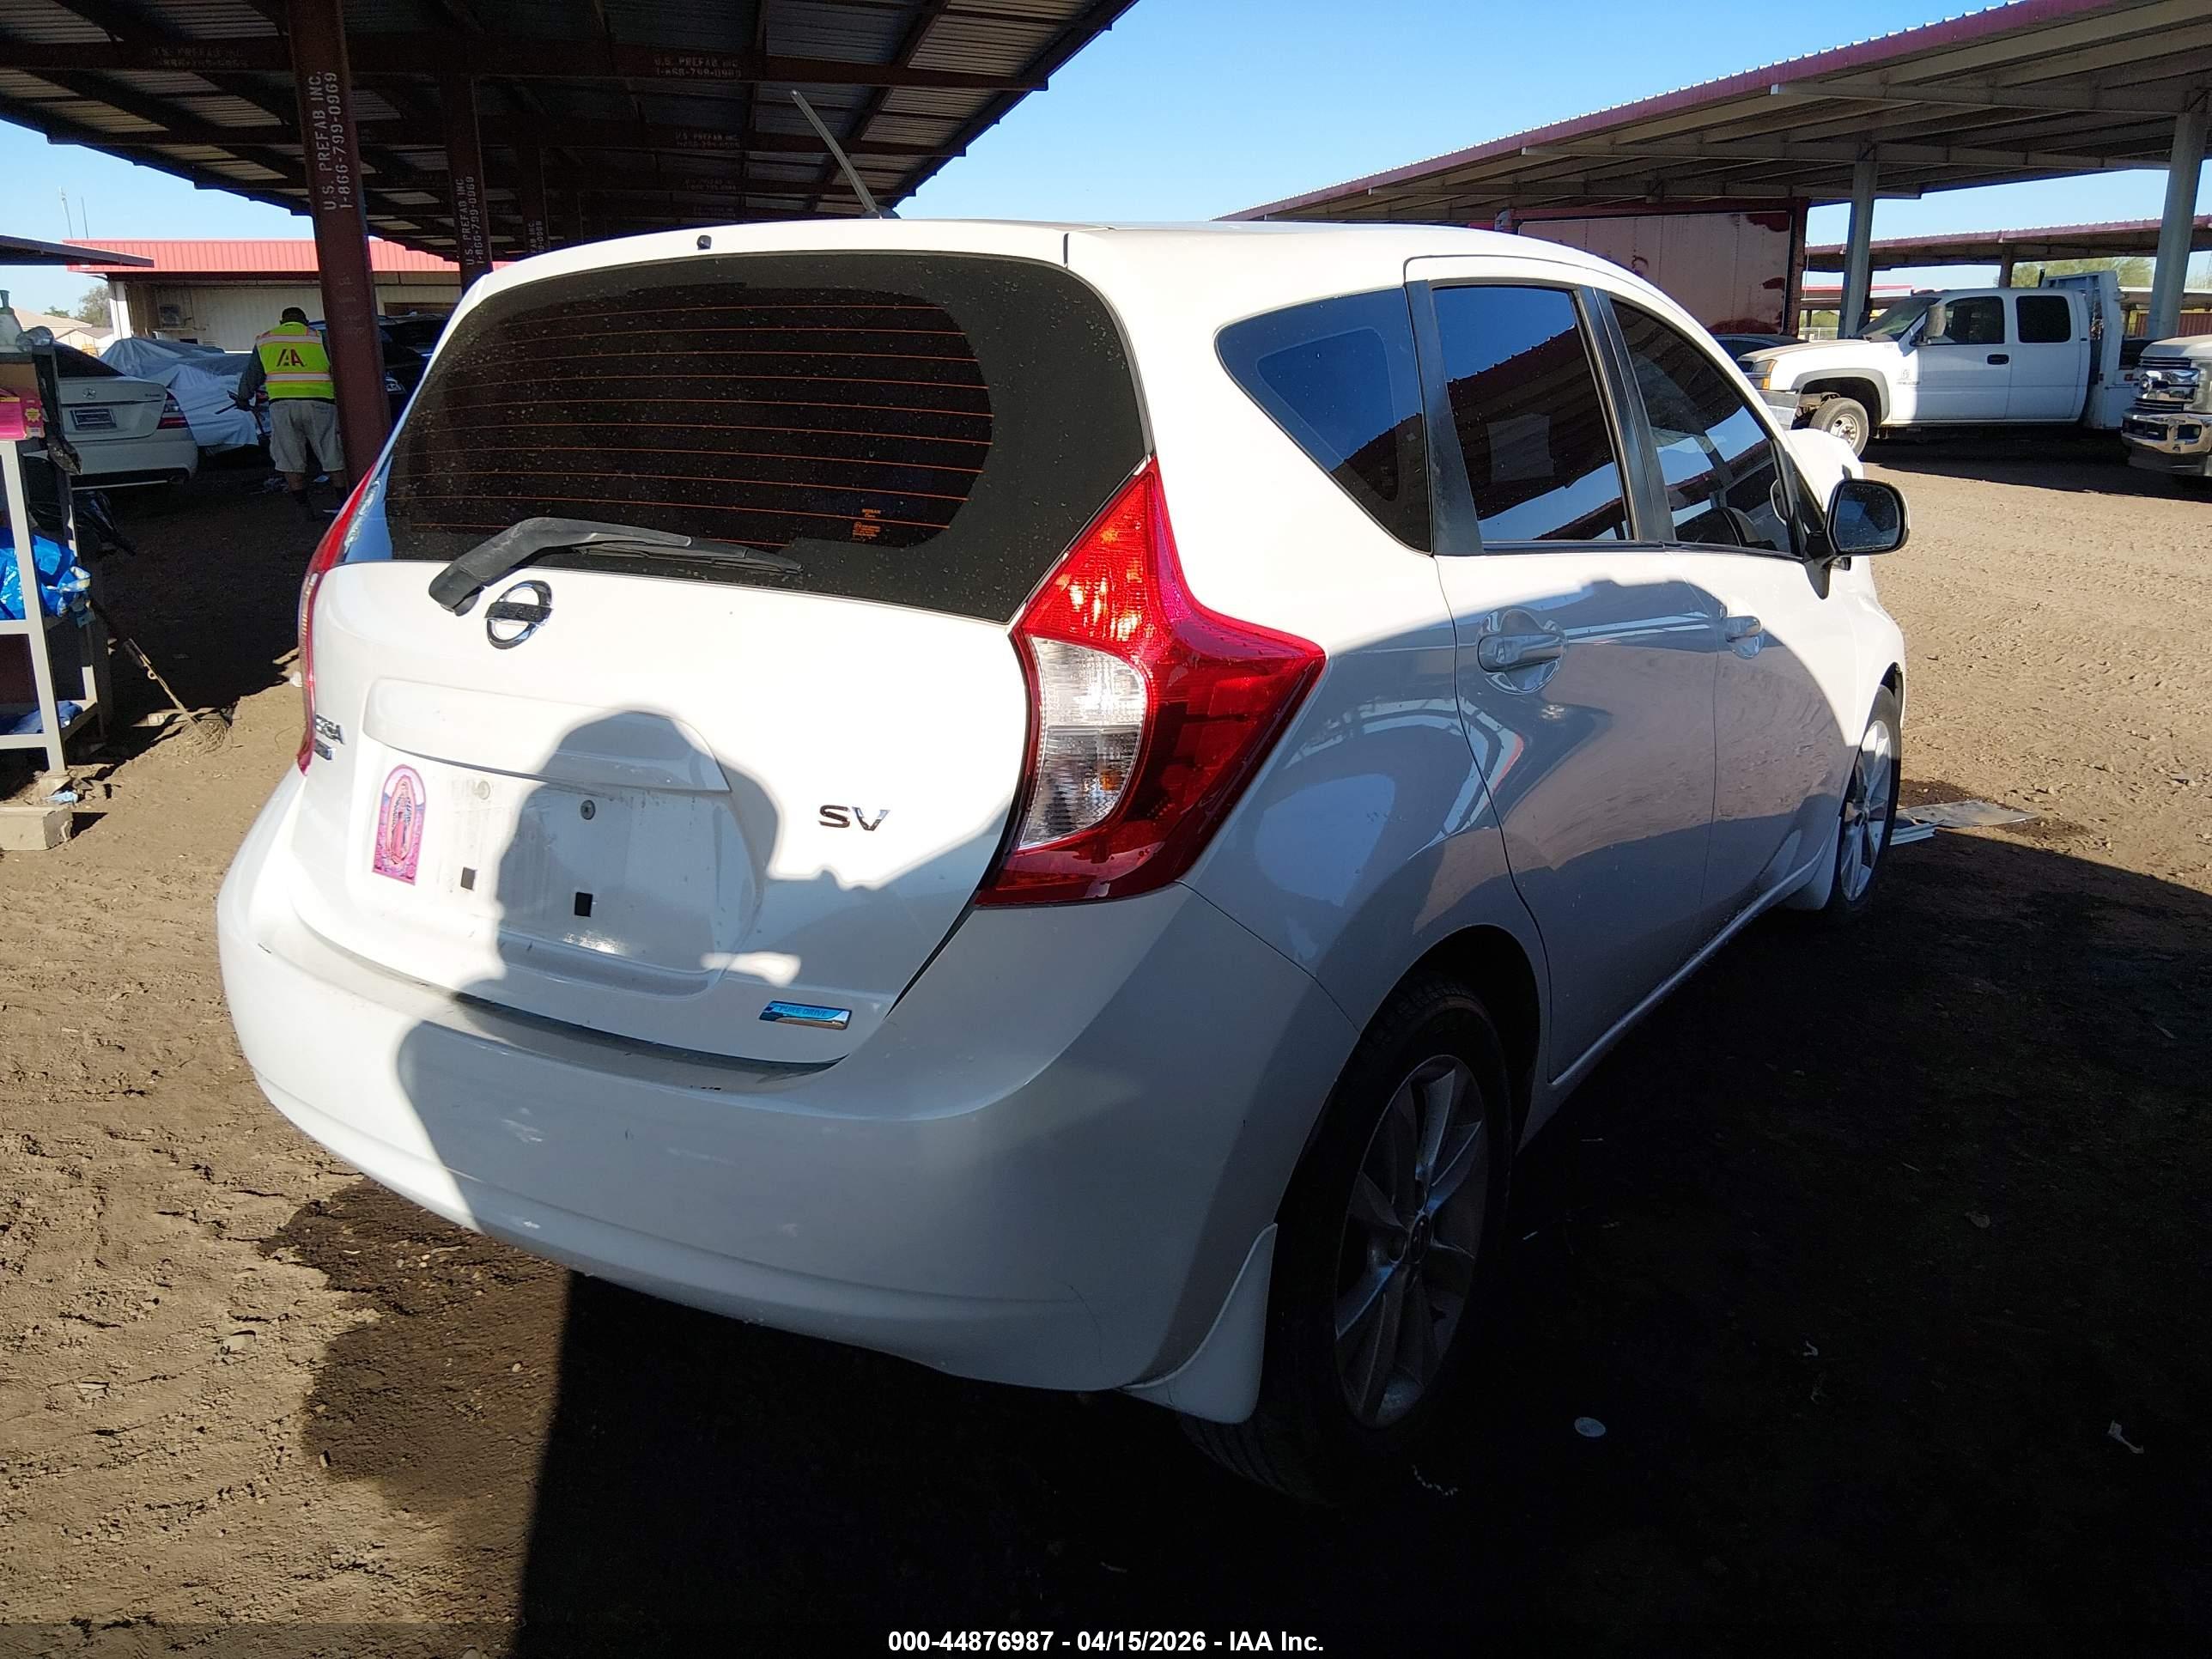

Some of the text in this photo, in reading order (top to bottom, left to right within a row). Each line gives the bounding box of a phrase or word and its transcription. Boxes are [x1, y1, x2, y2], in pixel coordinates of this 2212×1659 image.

[308, 70, 337, 210] U.S. PREFAB INC.
[324, 72, 354, 209] 1-866-799-0969
[458, 200, 471, 241] PREFAB
[817, 805, 891, 831] SV
[773, 1004, 831, 1018] PURE DRIVE
